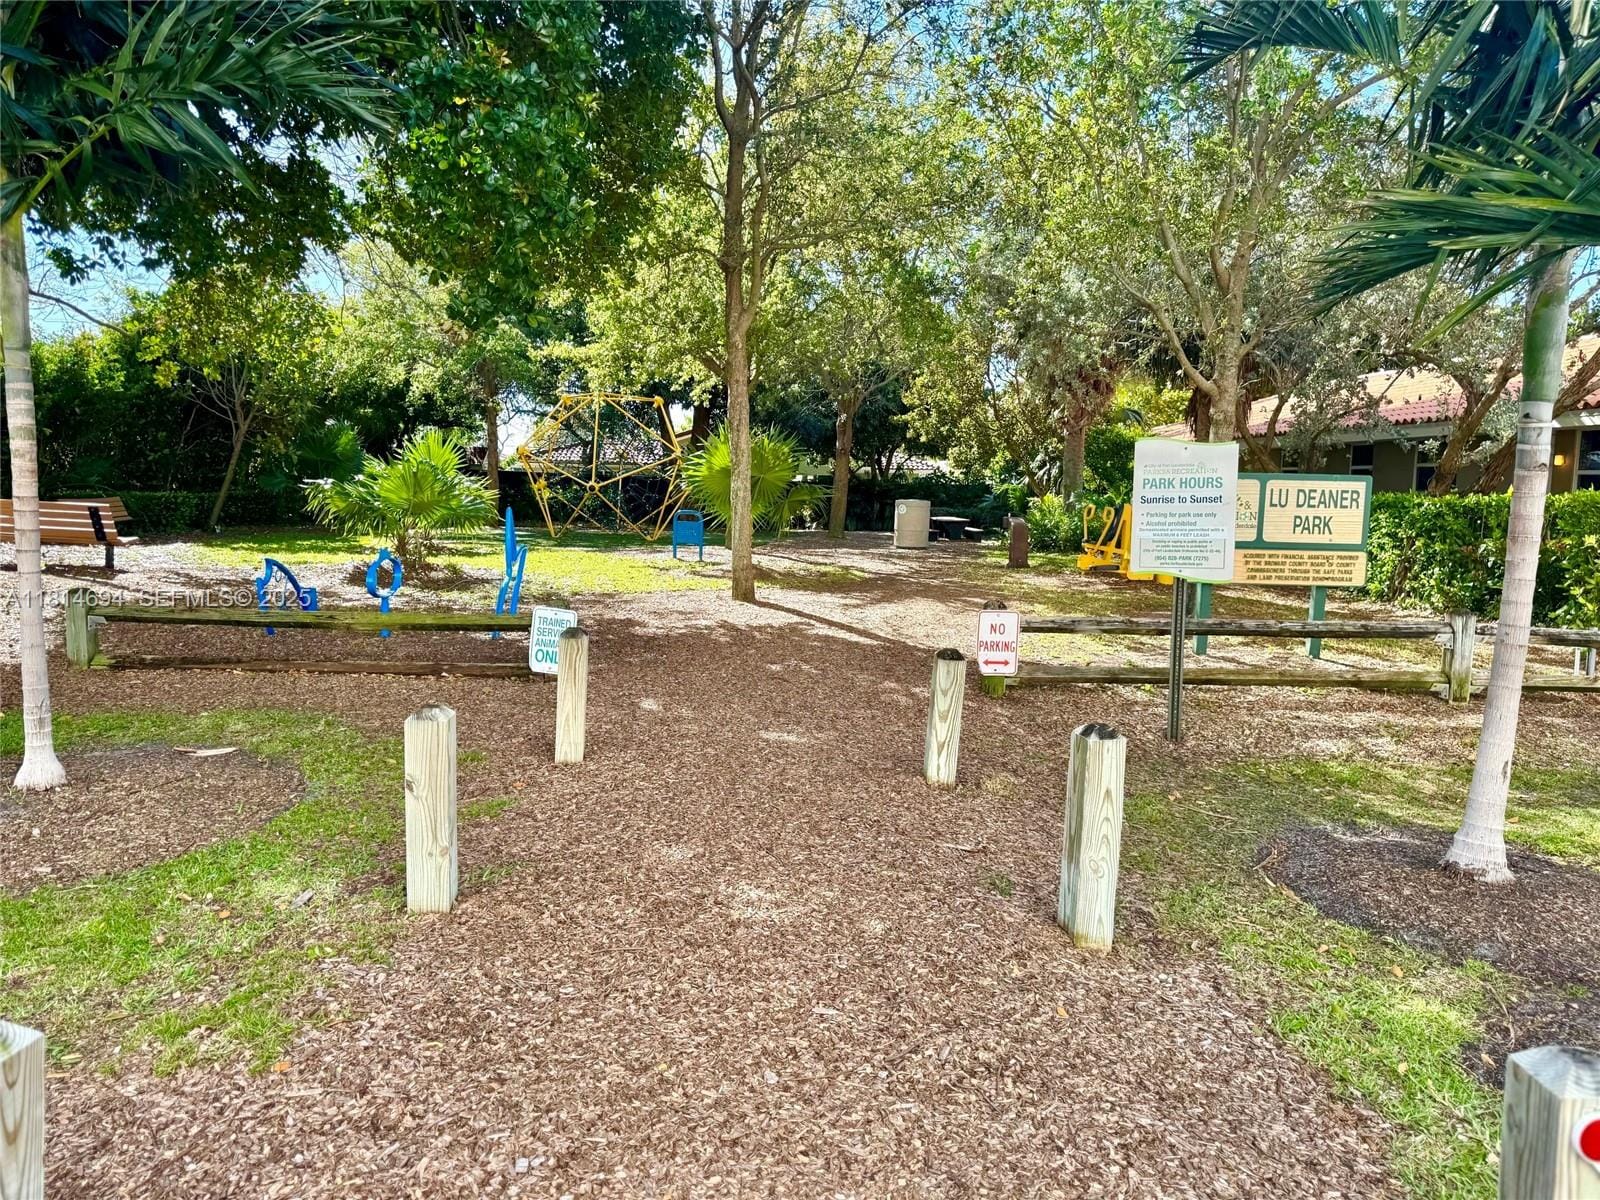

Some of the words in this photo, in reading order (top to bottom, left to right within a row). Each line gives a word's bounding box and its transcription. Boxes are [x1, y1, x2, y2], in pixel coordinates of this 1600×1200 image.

[1142, 478, 1176, 489] PARK
[1180, 476, 1223, 488] HOURS
[1140, 495, 1175, 504] Sunrise
[1178, 495, 1187, 504] to
[1190, 494, 1223, 504] Sunset
[1269, 488, 1289, 508] LU
[1296, 488, 1360, 510] DEANER
[1292, 515, 1333, 535] PARK
[538, 616, 572, 628] TRAINED
[990, 623, 1006, 636] NO
[979, 640, 1016, 652] PARKING
[535, 648, 558, 664] ONL
